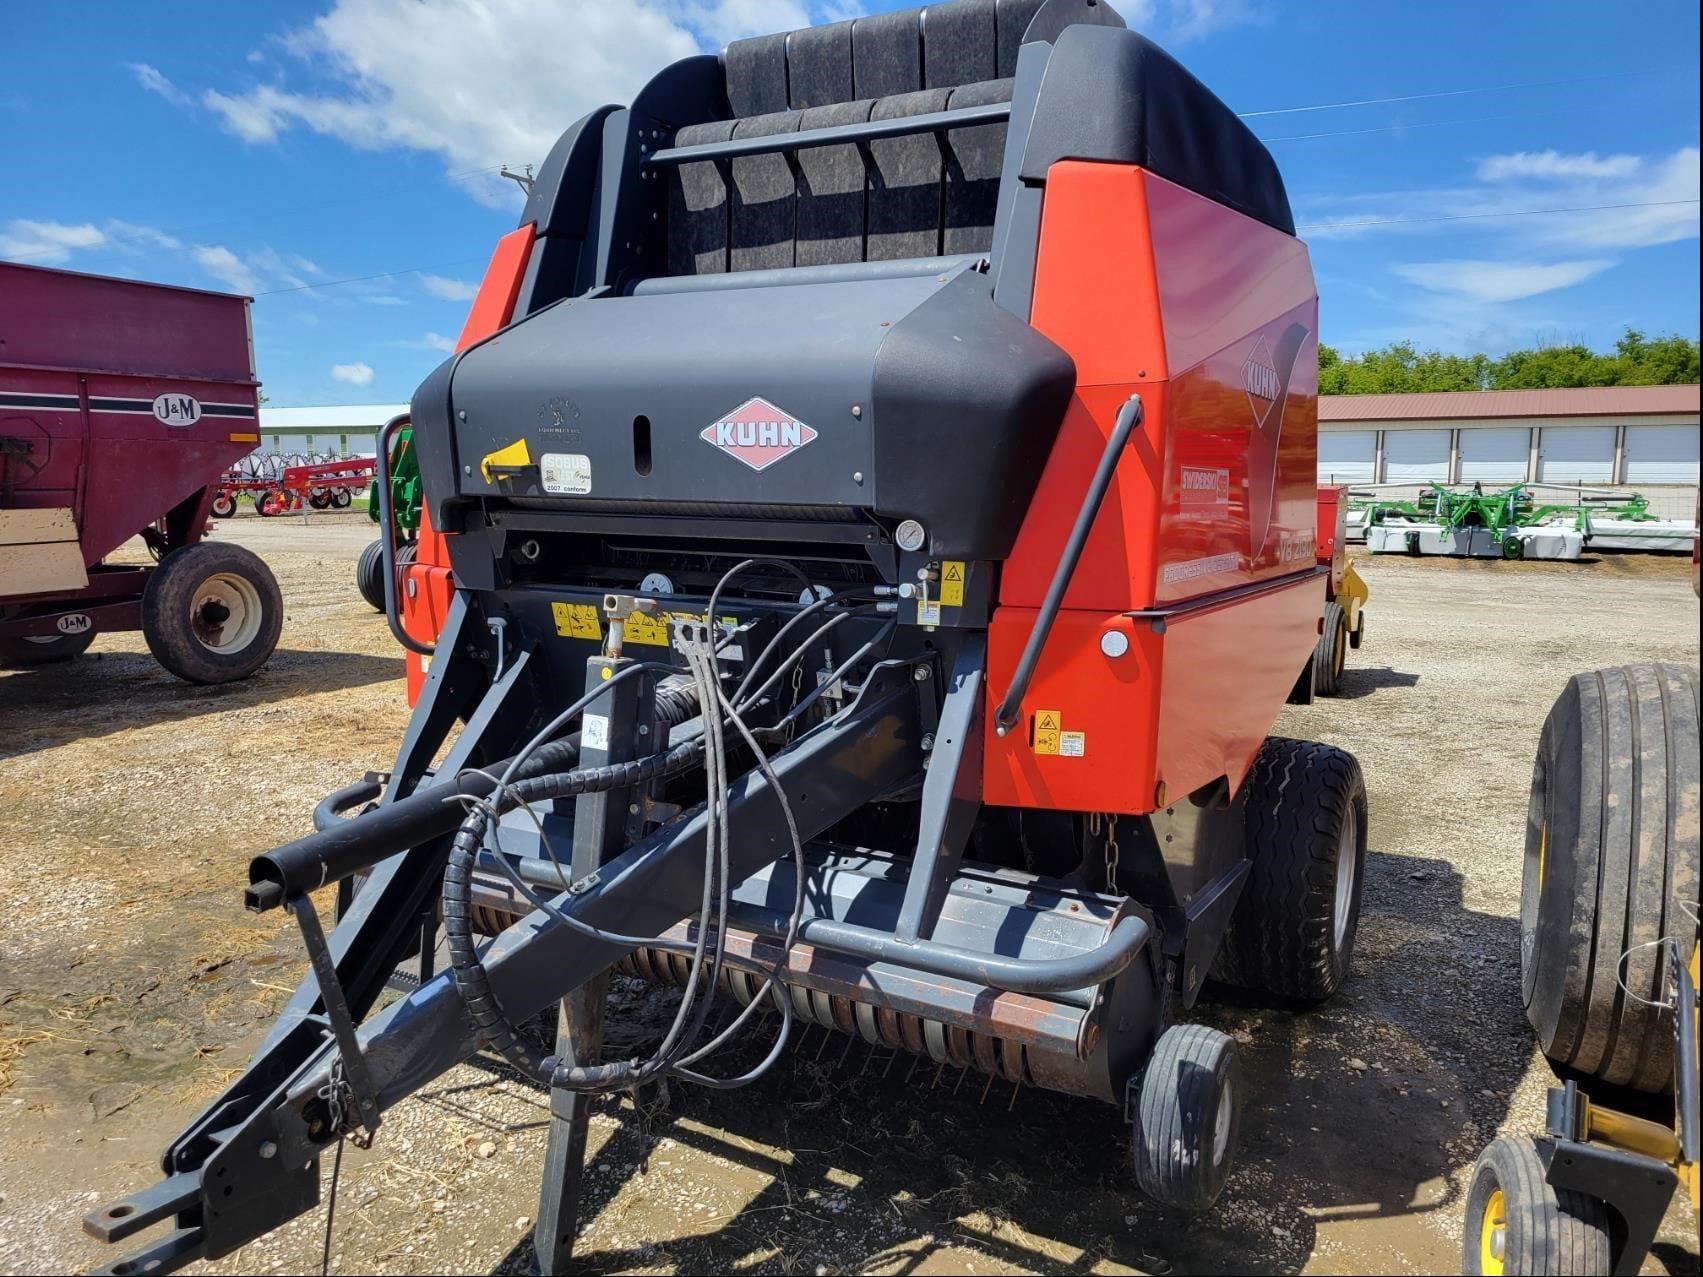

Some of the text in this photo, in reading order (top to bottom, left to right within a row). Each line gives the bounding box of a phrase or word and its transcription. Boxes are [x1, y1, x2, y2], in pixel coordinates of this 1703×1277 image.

[1247, 360, 1277, 401] KUHN
[156, 397, 197, 420] J&M
[716, 421, 802, 447] KUHN
[544, 455, 588, 470] ISOBUS
[1182, 470, 1217, 490] SWIDERSKI
[59, 615, 88, 630] J&M
